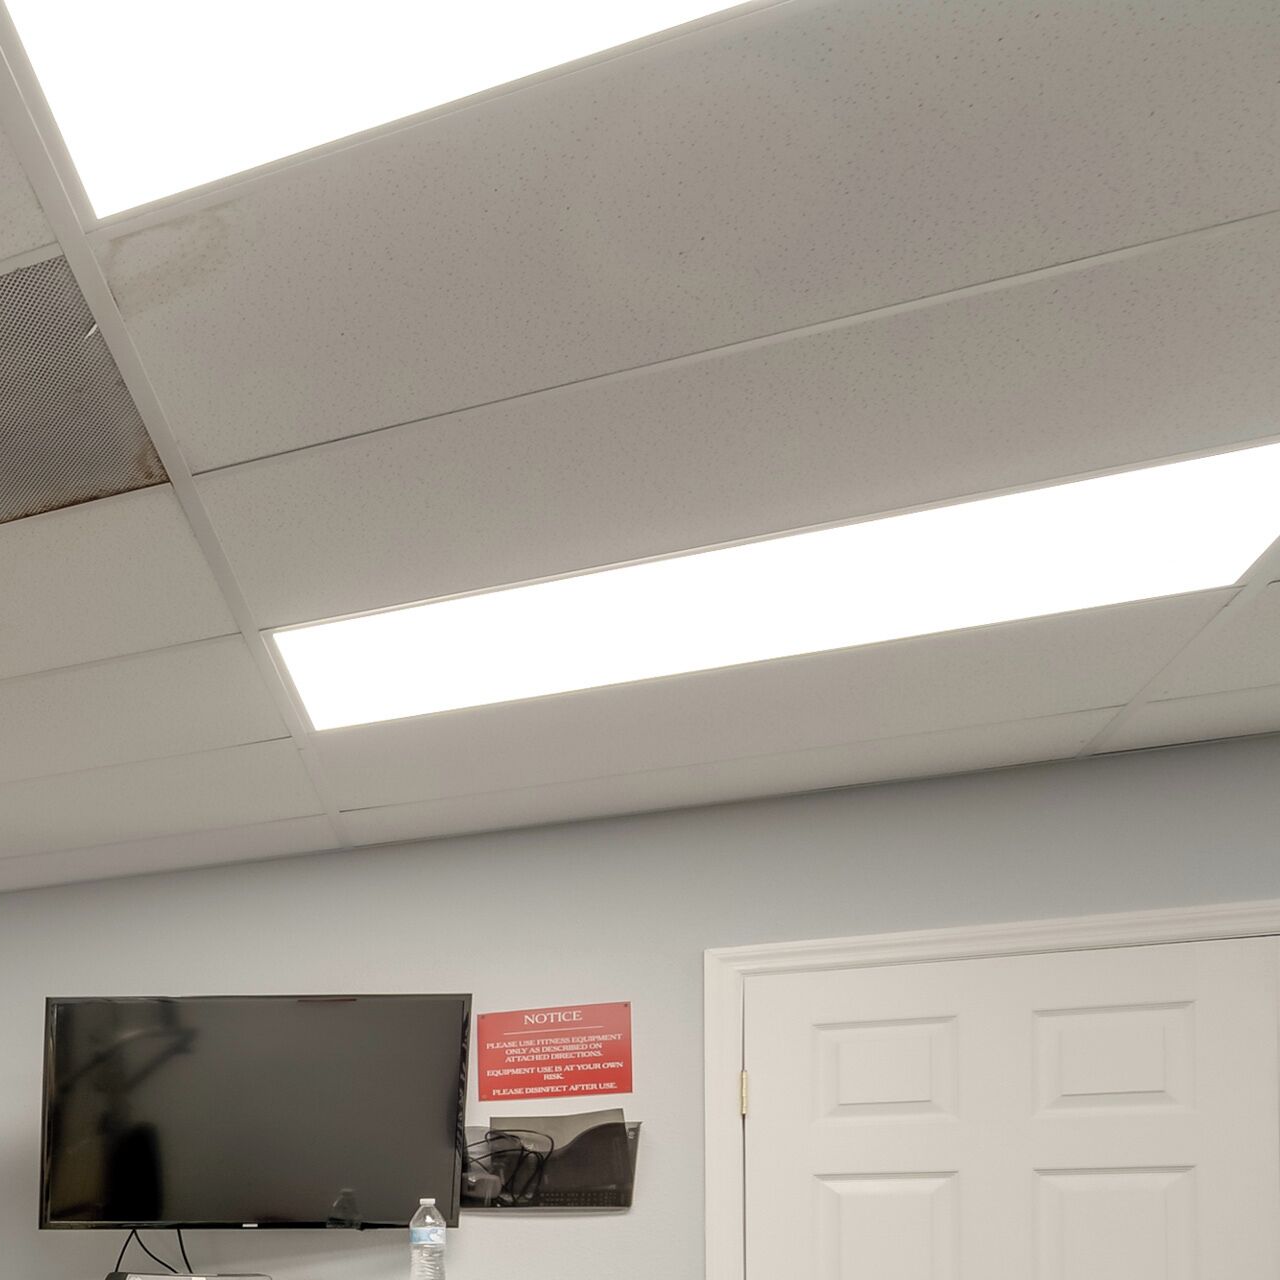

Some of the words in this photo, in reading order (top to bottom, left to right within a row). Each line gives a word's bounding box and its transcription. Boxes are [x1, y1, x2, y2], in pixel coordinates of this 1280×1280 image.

[524, 1010, 583, 1025] NOTICE
[486, 1041, 518, 1050] PLEASE
[536, 1037, 570, 1046] FITNESS
[571, 1033, 623, 1044] EQUIPMENT
[505, 1048, 528, 1056] ONLY
[541, 1043, 587, 1053] DESCRIBED
[505, 1053, 550, 1063] ATTACHED
[486, 1067, 535, 1077] EQUIPMENT
[576, 1063, 601, 1071] YOUR
[601, 1061, 624, 1069] OWN
[543, 1073, 564, 1081] RISK.
[492, 1088, 524, 1096] PLEASE
[525, 1086, 568, 1095] DISINFECT
[568, 1084, 598, 1093] AFTER
[598, 1082, 618, 1090] USE.
